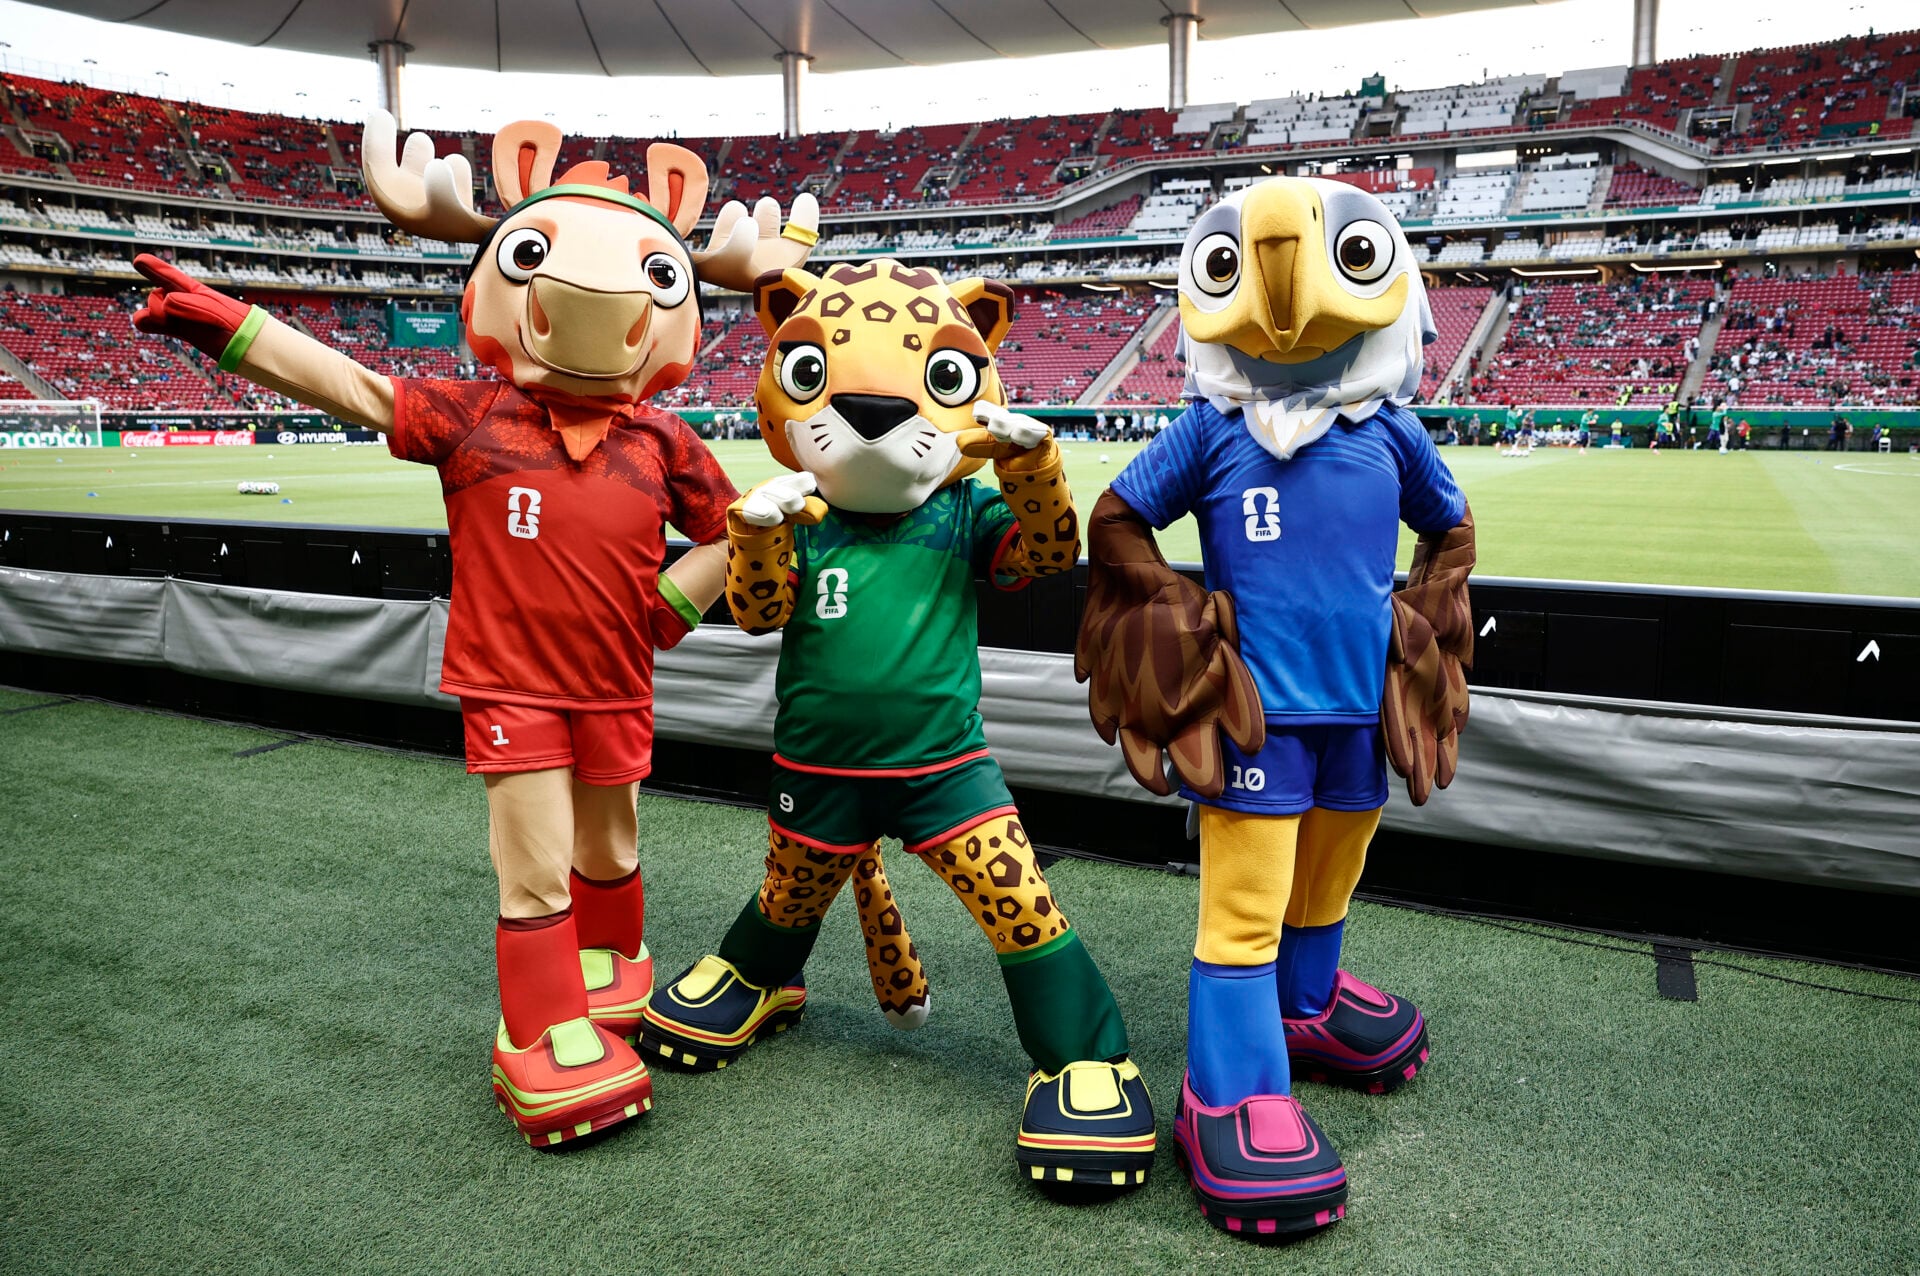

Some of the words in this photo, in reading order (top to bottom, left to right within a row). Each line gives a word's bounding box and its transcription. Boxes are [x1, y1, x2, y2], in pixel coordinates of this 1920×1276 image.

[1432, 216, 1508, 225] GUADALAJARA
[135, 232, 210, 243] GUADALAJARA
[0, 432, 92, 448] aramco
[123, 431, 166, 447] Coca-Cola
[214, 431, 251, 446] Coca-Cola
[299, 432, 347, 443] HYUNDAI
[516, 526, 530, 534] FIFA
[490, 725, 510, 746] 1
[1231, 765, 1265, 792] 10
[779, 792, 794, 813] 9
